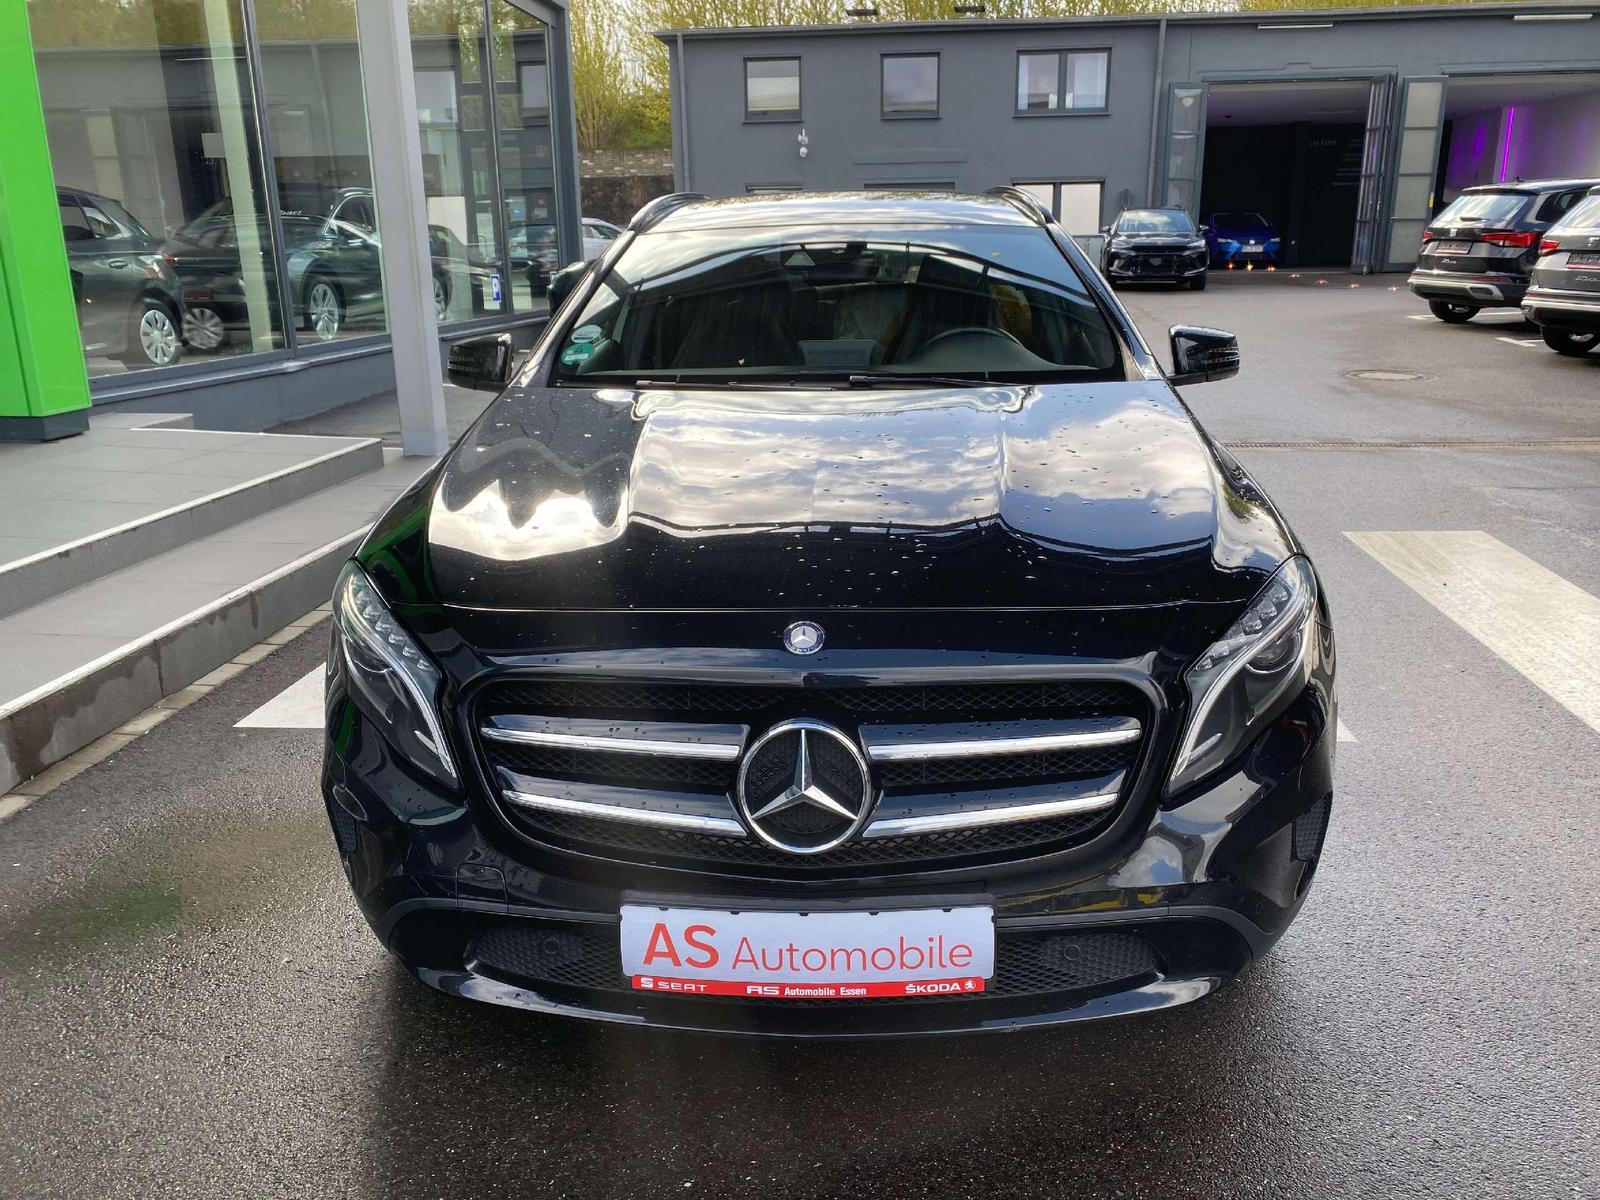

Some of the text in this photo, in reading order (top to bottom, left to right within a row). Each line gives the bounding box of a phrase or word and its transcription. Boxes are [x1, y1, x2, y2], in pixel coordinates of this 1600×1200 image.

[491, 277, 499, 300] P
[643, 923, 973, 972] AS Automobile
[657, 981, 708, 992] SEAT
[746, 985, 867, 996] AS Automobile Essen
[905, 982, 961, 995] ŠKODA
